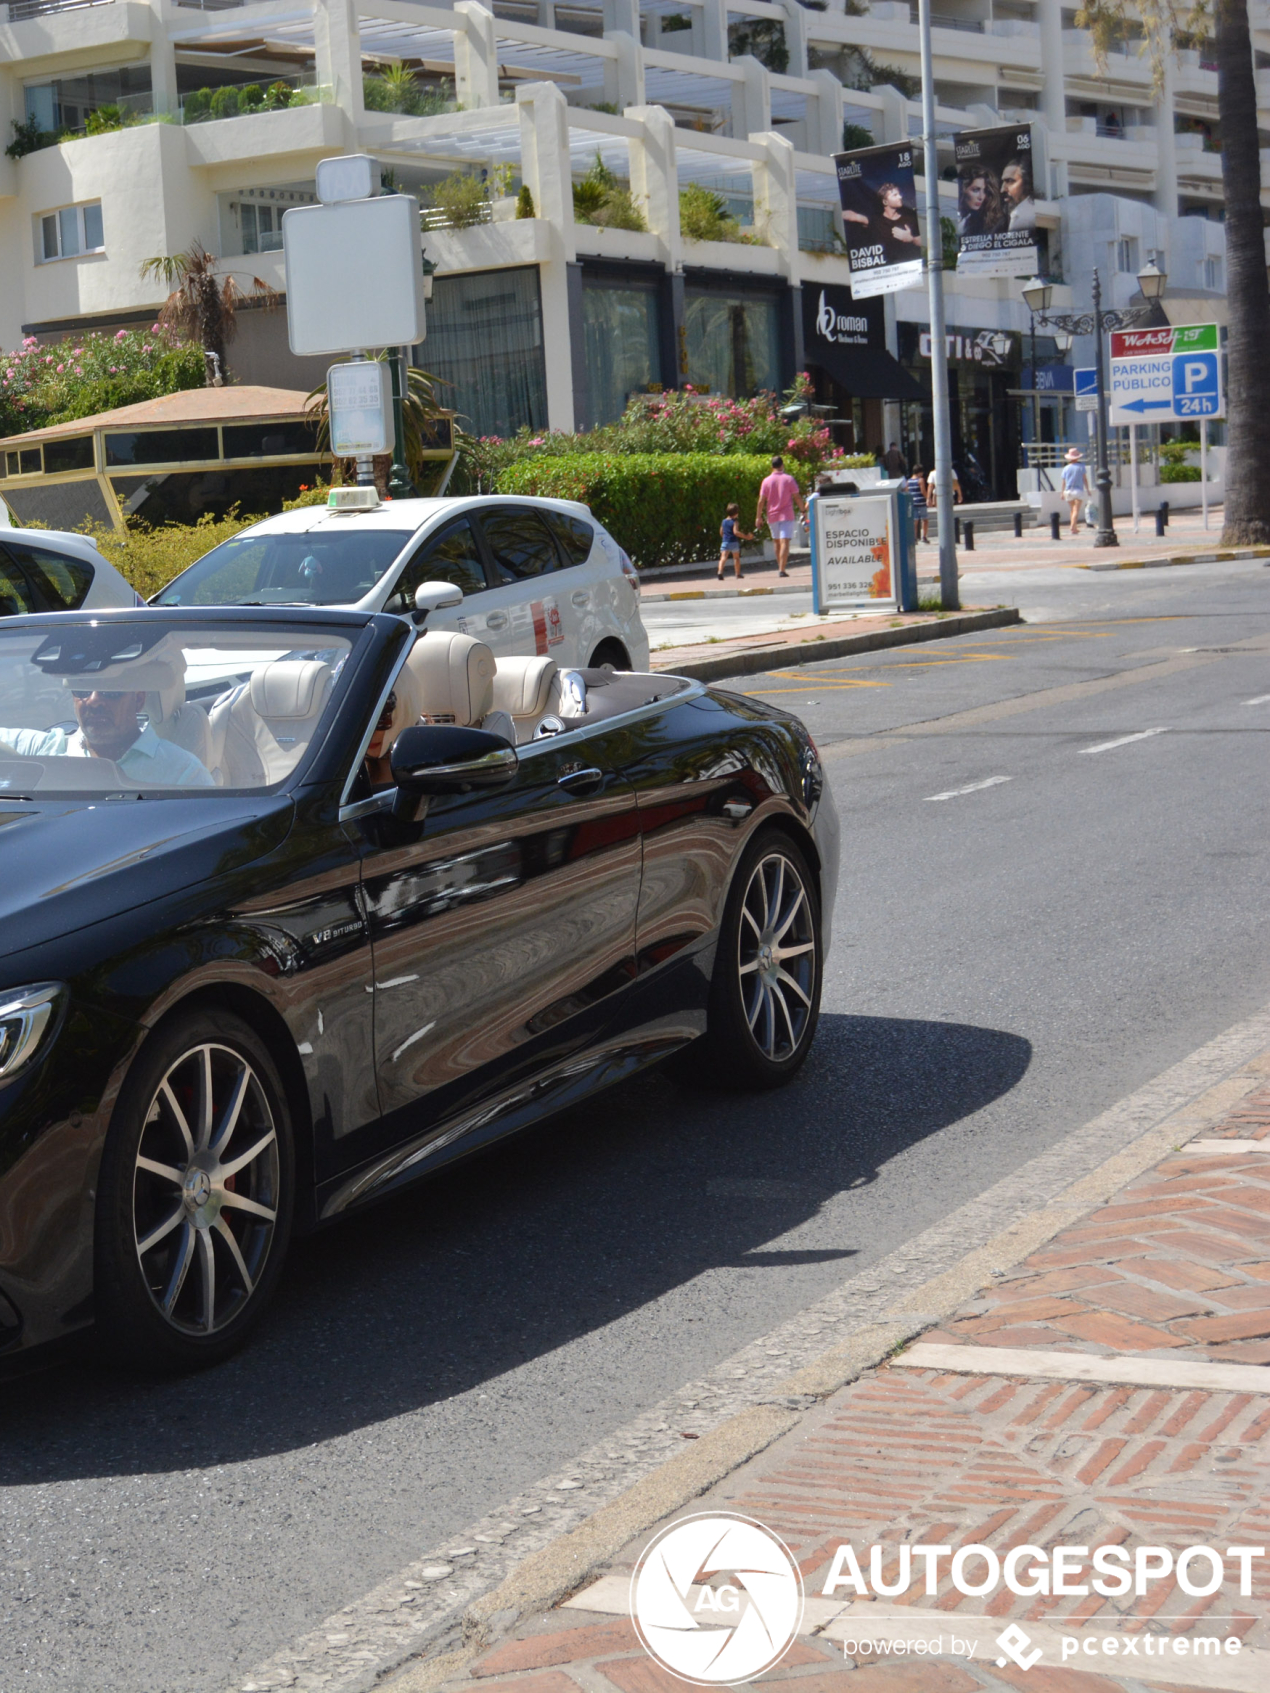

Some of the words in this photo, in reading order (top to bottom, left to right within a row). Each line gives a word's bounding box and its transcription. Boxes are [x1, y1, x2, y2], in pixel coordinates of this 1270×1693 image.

[1017, 134, 1029, 144] 06
[1017, 142, 1031, 150] AGO
[898, 152, 910, 163] 18
[898, 160, 912, 169] AGO
[961, 234, 993, 244] ESTRELLA
[994, 230, 1029, 240] MORENTE
[968, 241, 993, 251] DIEGO
[994, 240, 1002, 248] EL
[1003, 238, 1034, 247] CIGALA
[850, 244, 883, 261] DAVID
[851, 253, 886, 270] BISBAL
[837, 315, 868, 332] roman
[1122, 330, 1182, 347] WASH
[1112, 362, 1171, 377] PARKING
[1113, 376, 1171, 391] PÚBLICO
[1185, 362, 1208, 393] P
[826, 529, 869, 539] ESPACIO
[826, 537, 887, 549] DISPONIBLE
[827, 554, 883, 565] AVAILABLE
[312, 929, 331, 944] V8
[332, 921, 363, 938] BITURBO
